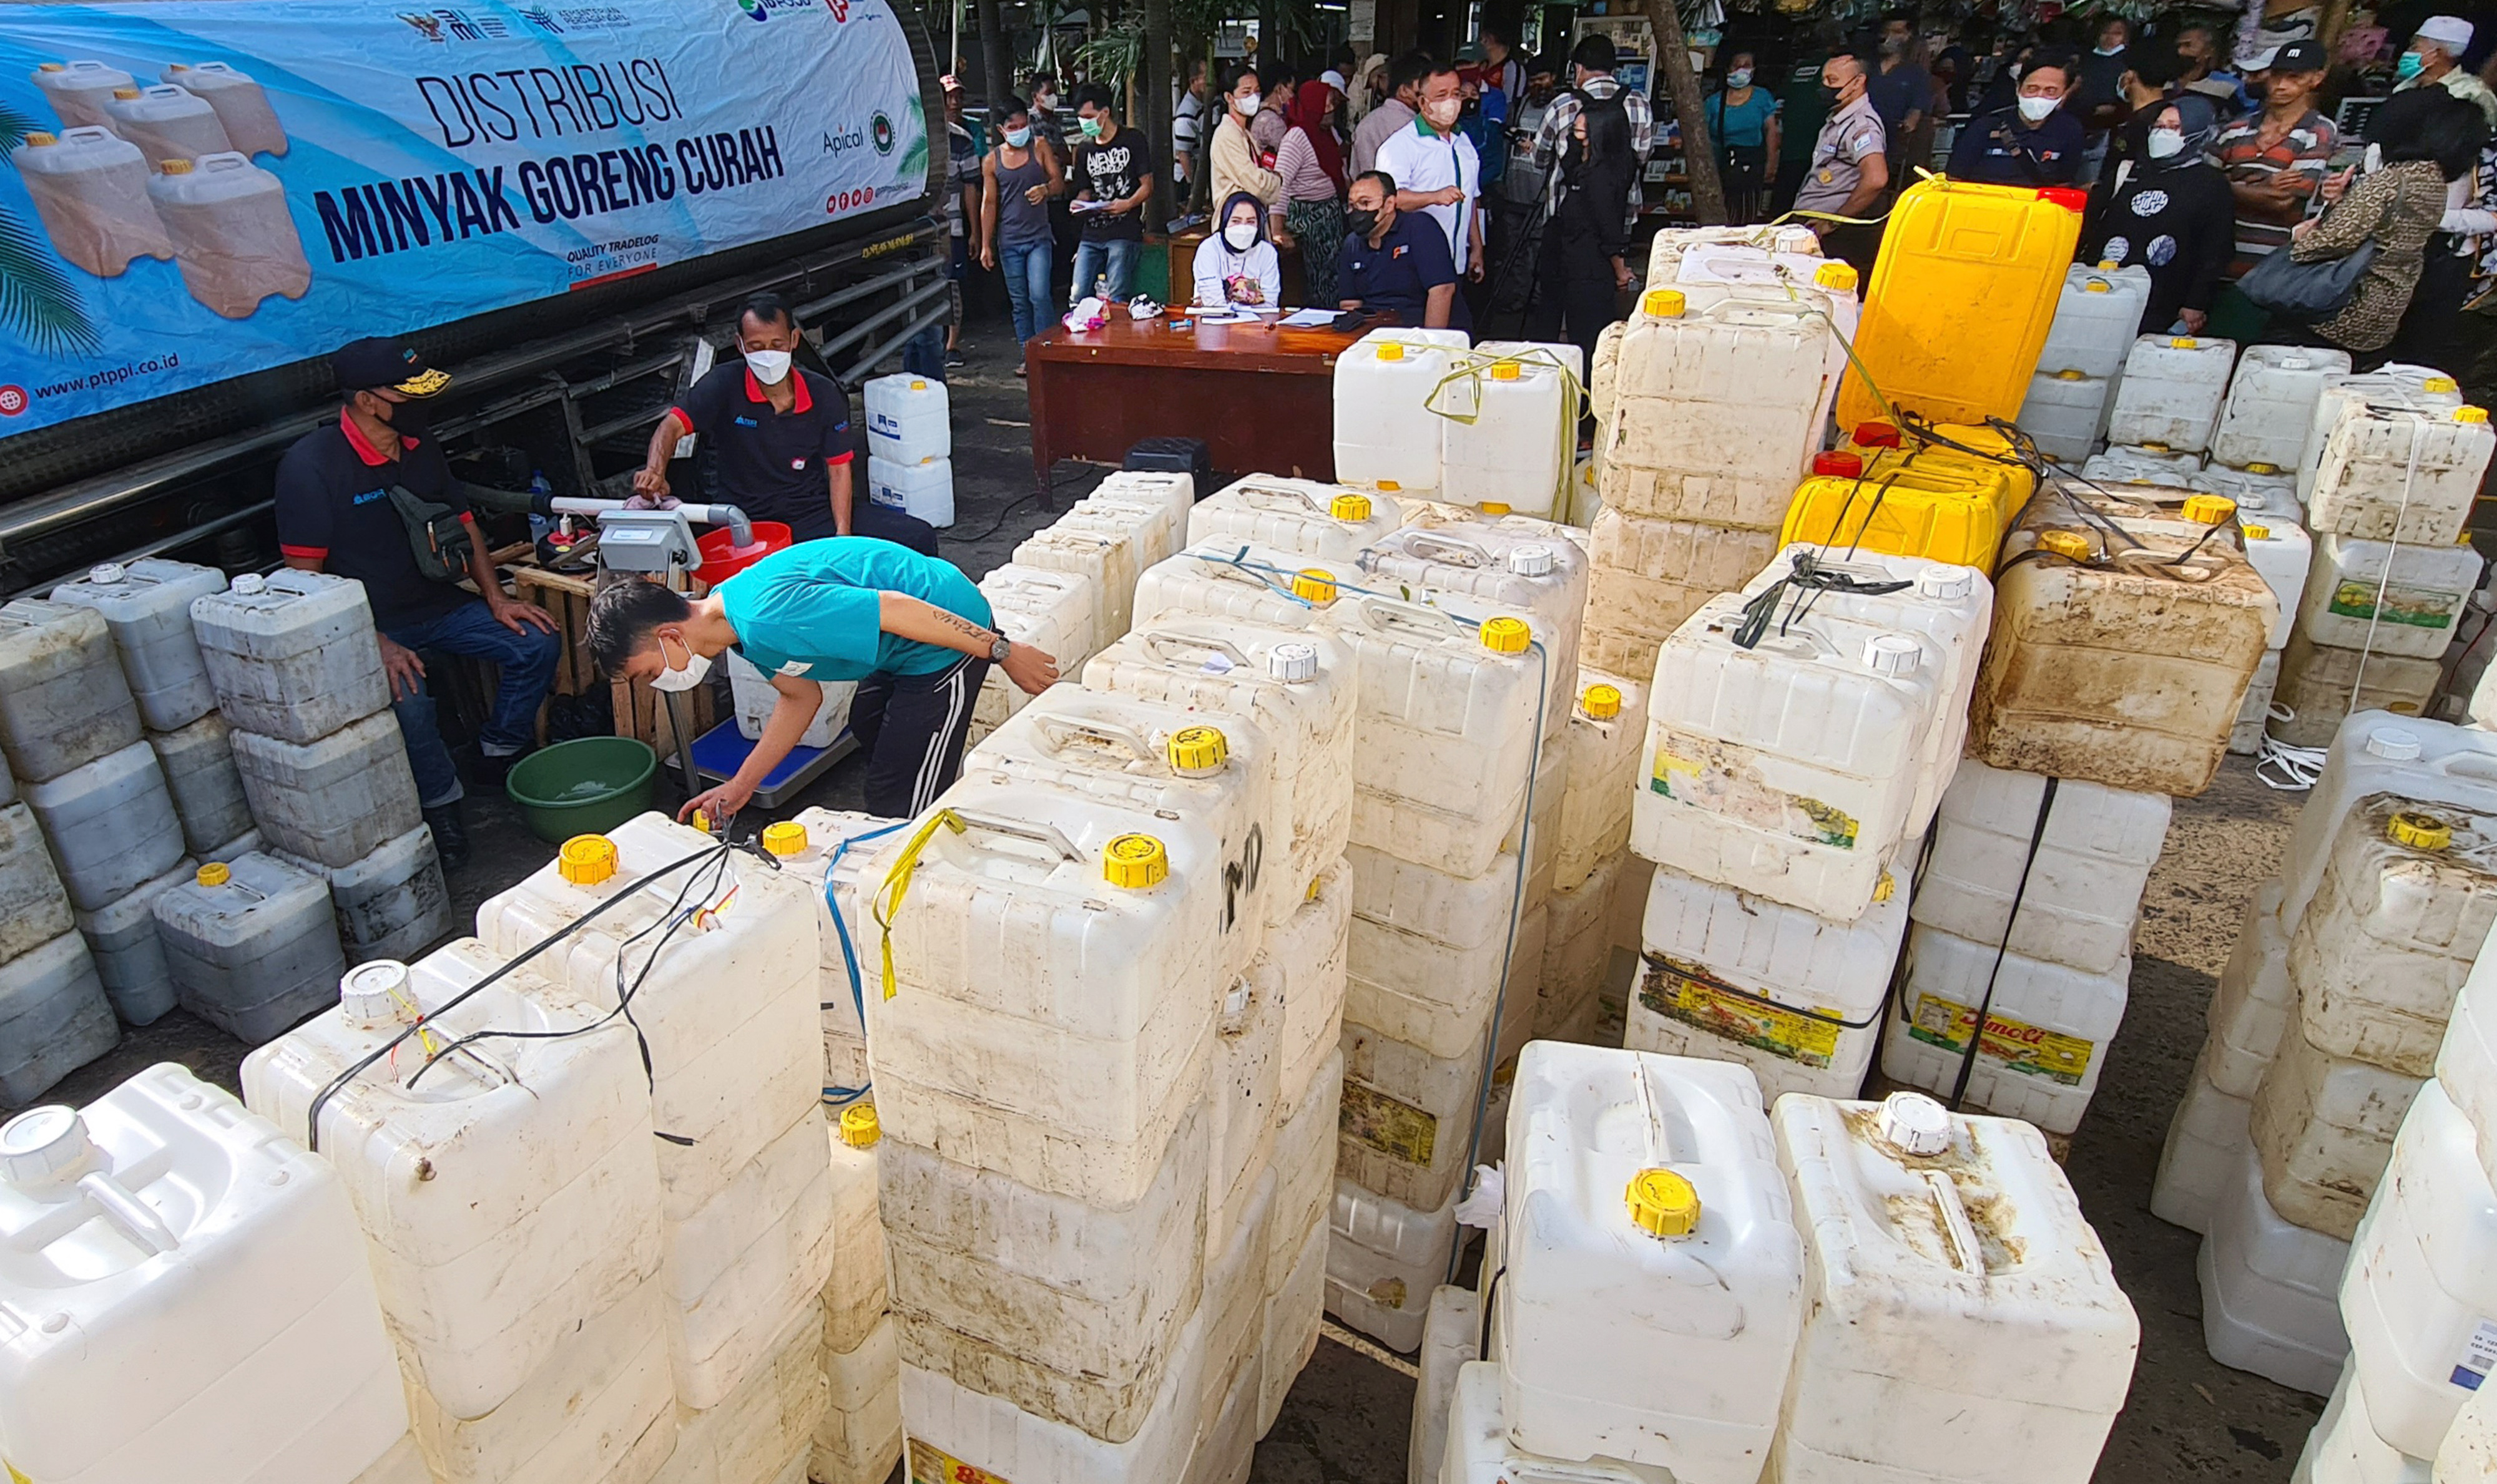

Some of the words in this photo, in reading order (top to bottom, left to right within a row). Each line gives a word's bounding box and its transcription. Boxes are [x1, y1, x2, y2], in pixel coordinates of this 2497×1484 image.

[416, 58, 682, 148] DISTRIBUSI
[823, 124, 864, 158] Apical
[1087, 147, 1131, 170] AVENGED
[314, 166, 521, 263] MINYAK
[518, 144, 675, 223] GORENG
[675, 125, 784, 195] CURAH
[567, 243, 607, 263] QUALITY
[609, 234, 659, 252] TRADELOG
[568, 263, 592, 278] FOR
[598, 247, 656, 271] EVERYONE
[34, 353, 179, 398] www.ptppi.co.id
